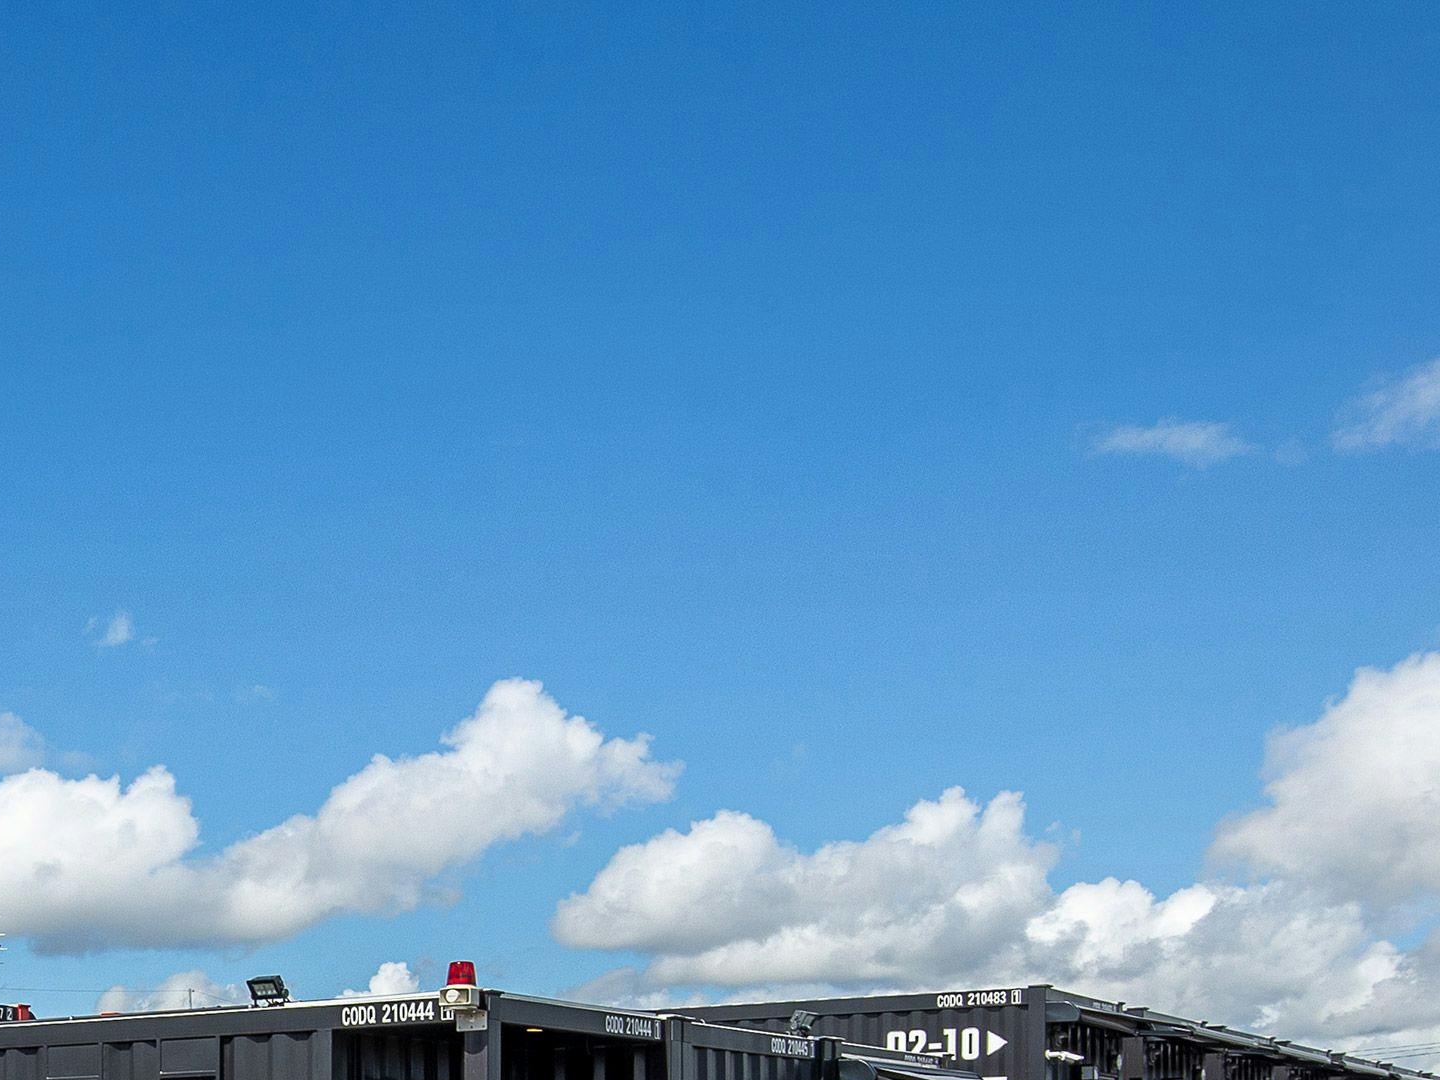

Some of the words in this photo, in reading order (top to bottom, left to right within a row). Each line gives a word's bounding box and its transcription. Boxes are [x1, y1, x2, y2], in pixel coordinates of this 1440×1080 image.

[936, 993, 963, 1008] CODQ
[967, 990, 1007, 1006] 210483
[341, 1005, 377, 1027] CODQ
[382, 1001, 435, 1024] 210444
[605, 1015, 624, 1033] CODQ
[626, 1018, 652, 1037] 210444
[787, 1040, 808, 1056] 210445
